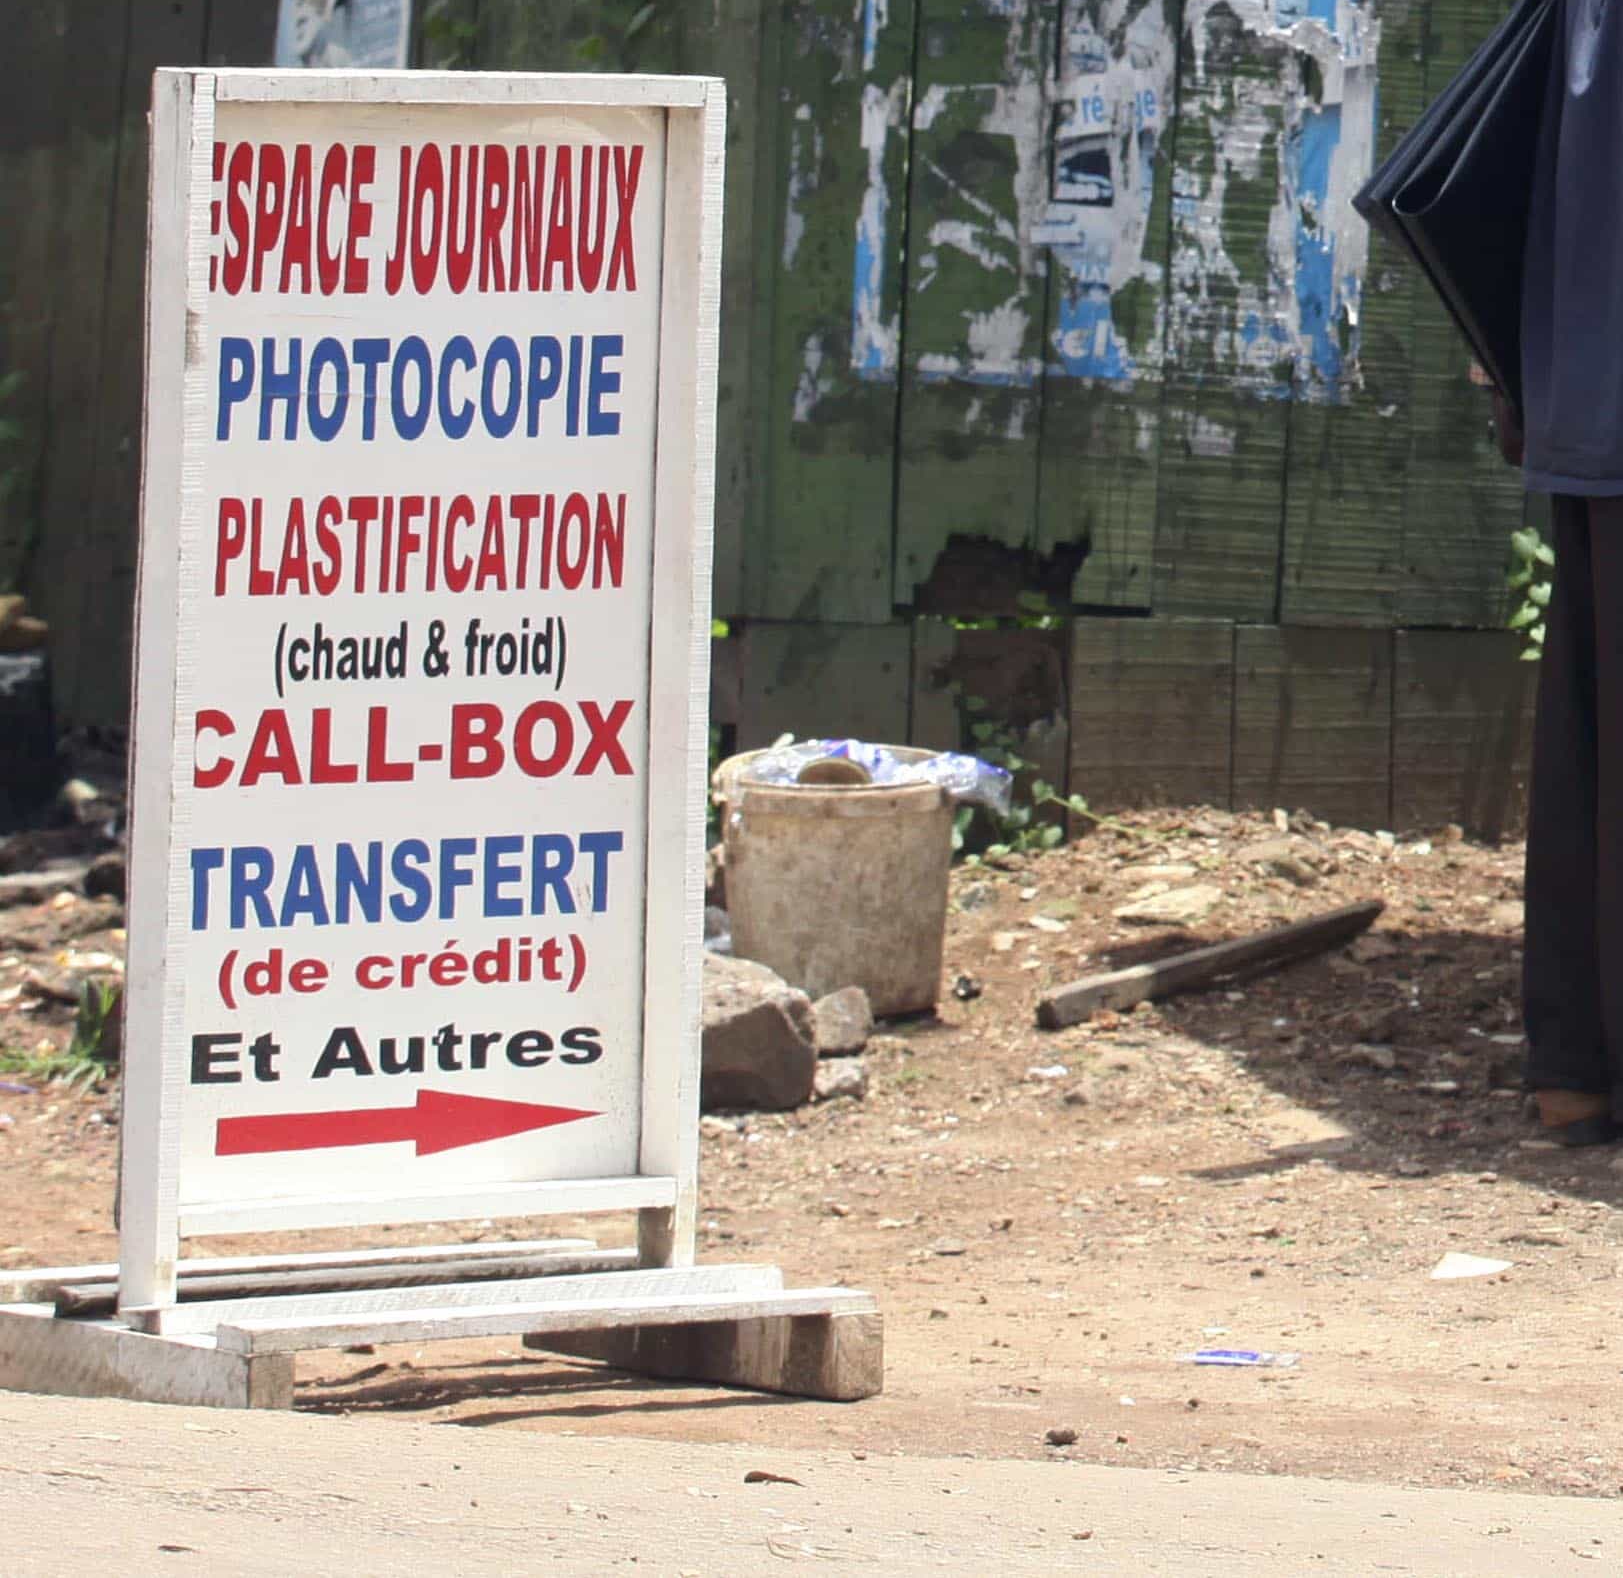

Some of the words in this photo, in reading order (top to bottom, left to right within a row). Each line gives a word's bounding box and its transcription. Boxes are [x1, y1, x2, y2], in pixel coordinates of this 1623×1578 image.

[385, 143, 644, 295] JOURNAUX
[216, 335, 623, 442] PHOTOCOPIE
[215, 493, 626, 597] PLASTIFICATION
[275, 621, 407, 697] (chaud
[423, 619, 449, 678] &
[466, 616, 566, 690] froid)
[194, 700, 635, 789] CALL-BOX
[191, 831, 623, 930] TRANSFERT
[219, 949, 328, 1010] (de
[355, 934, 586, 992] crédit)
[191, 1032, 280, 1085] Et
[311, 1023, 603, 1078] Autres
